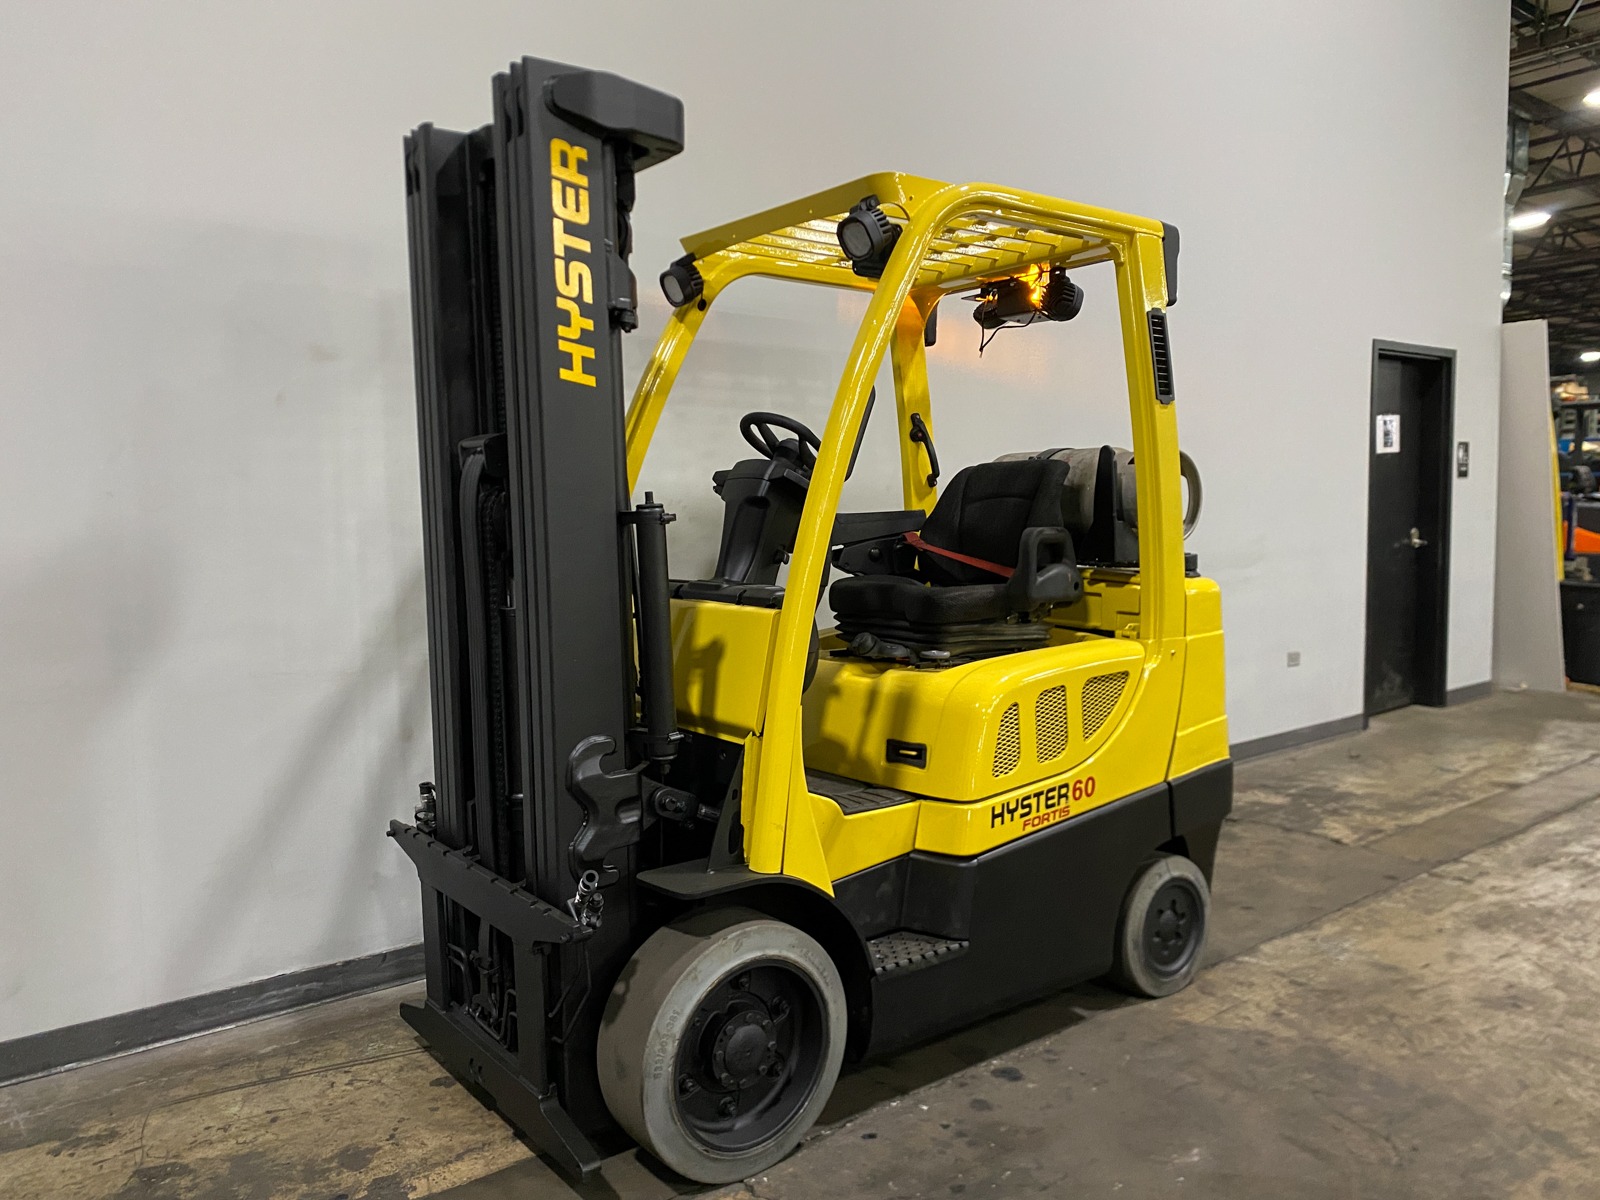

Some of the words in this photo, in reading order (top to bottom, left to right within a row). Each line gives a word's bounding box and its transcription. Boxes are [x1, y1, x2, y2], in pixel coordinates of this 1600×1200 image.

[550, 137, 597, 388] HYSTER
[991, 782, 1069, 829] HYSTER
[1072, 776, 1096, 801] 60
[1022, 805, 1070, 831] FORTIS
